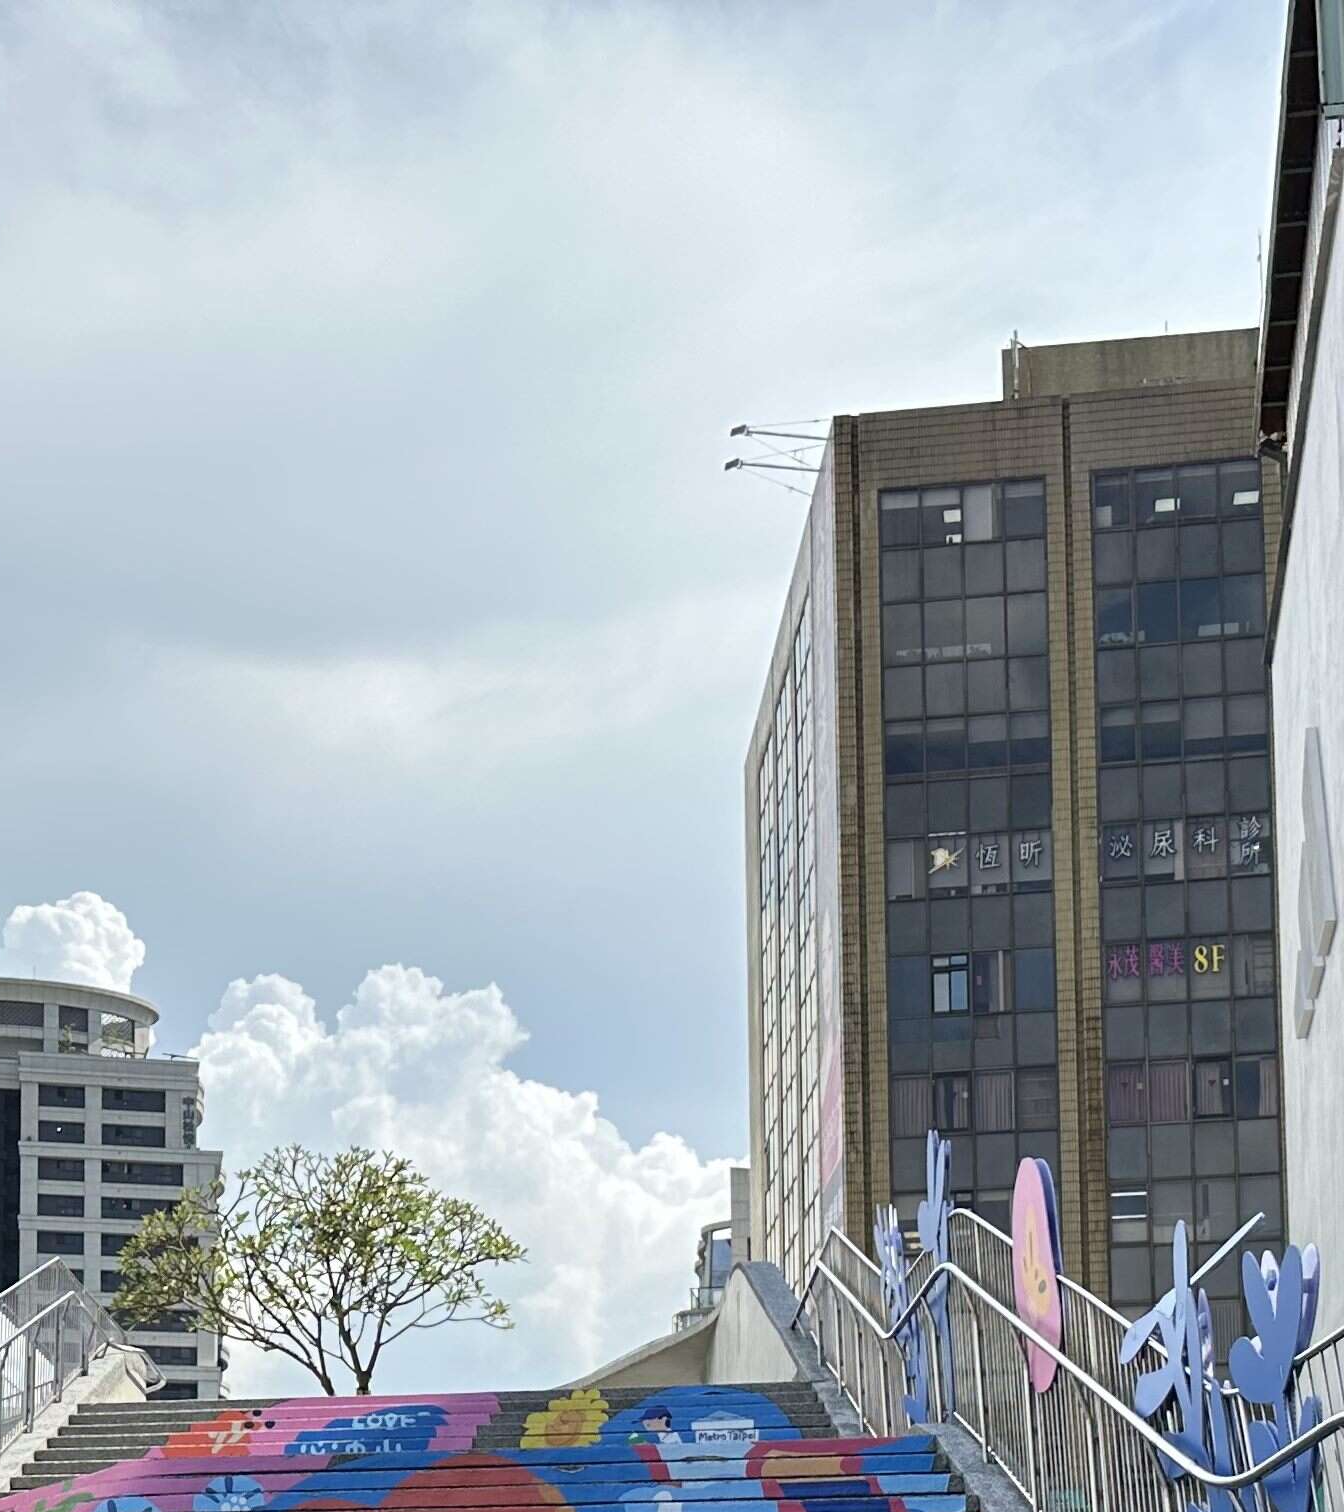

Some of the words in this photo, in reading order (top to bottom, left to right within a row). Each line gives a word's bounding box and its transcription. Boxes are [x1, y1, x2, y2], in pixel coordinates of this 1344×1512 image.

[1109, 816, 1262, 866] 泌尿科診所
[1194, 945, 1224, 973] 8F
[699, 1432, 726, 1441] Metro
